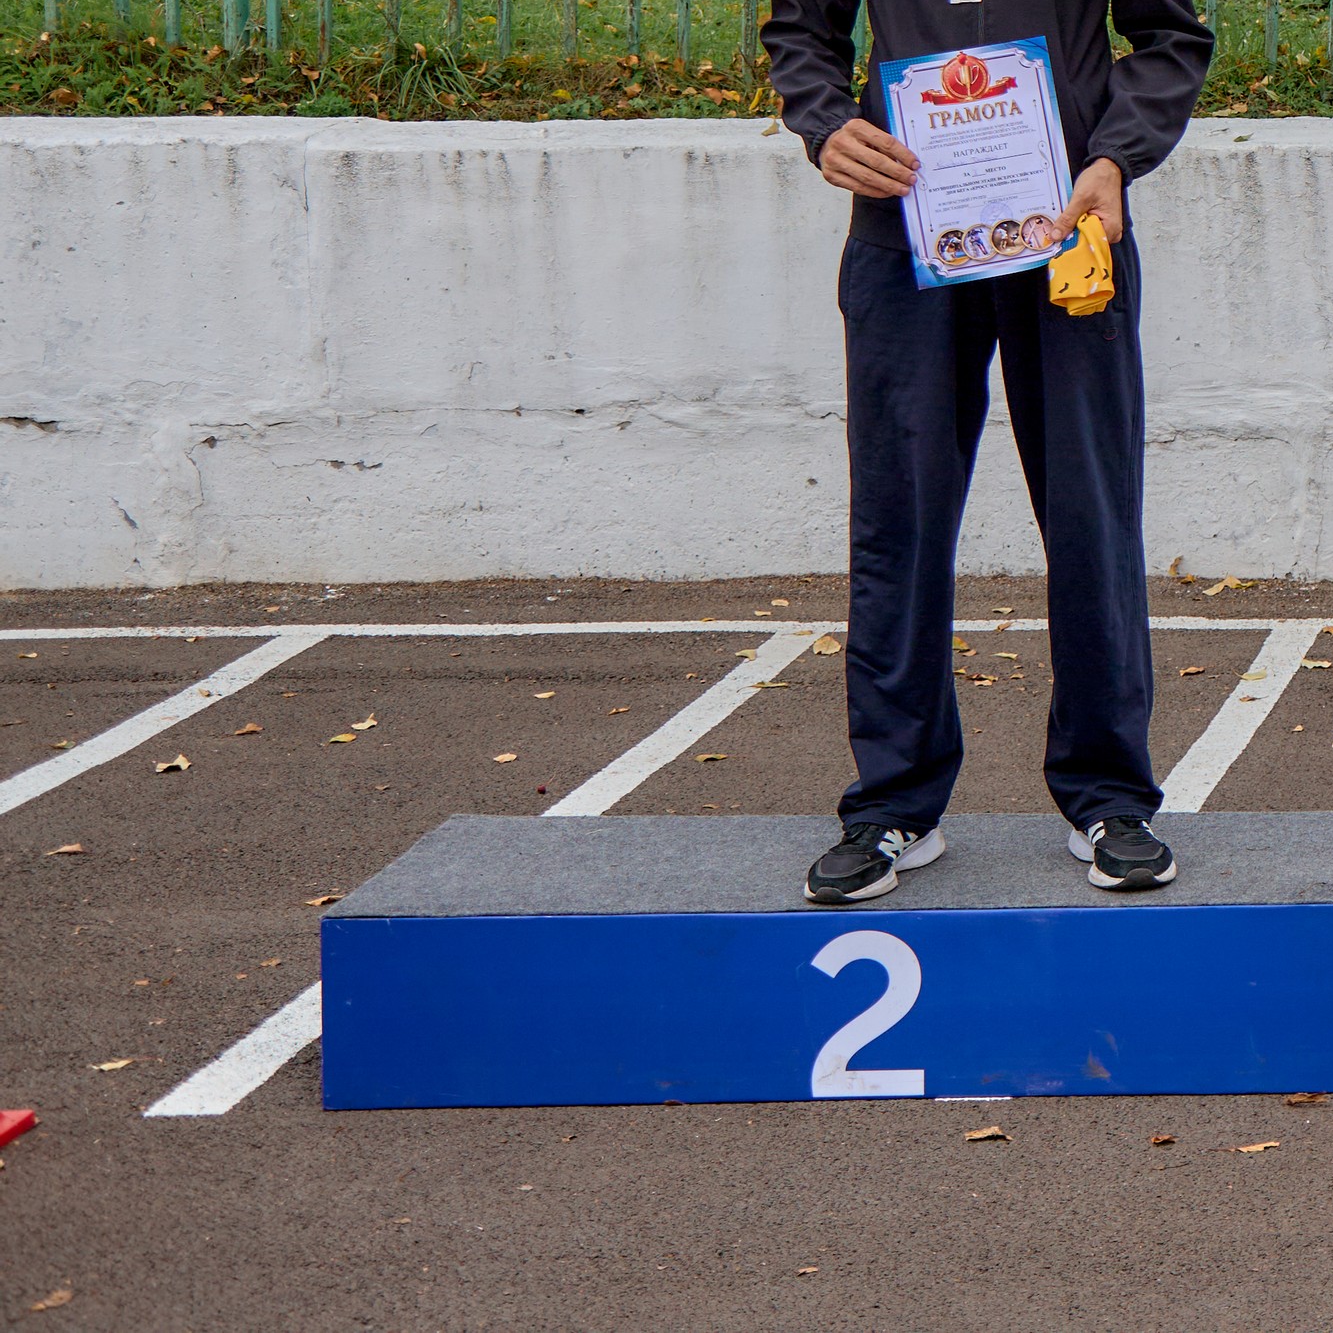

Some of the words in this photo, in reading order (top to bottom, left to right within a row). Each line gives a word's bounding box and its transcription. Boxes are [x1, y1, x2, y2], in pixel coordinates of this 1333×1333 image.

[928, 99, 1023, 129] ГРАМОТА
[953, 142, 1008, 158] НАГРАЖДАЕТ
[811, 930, 925, 1098] 2
